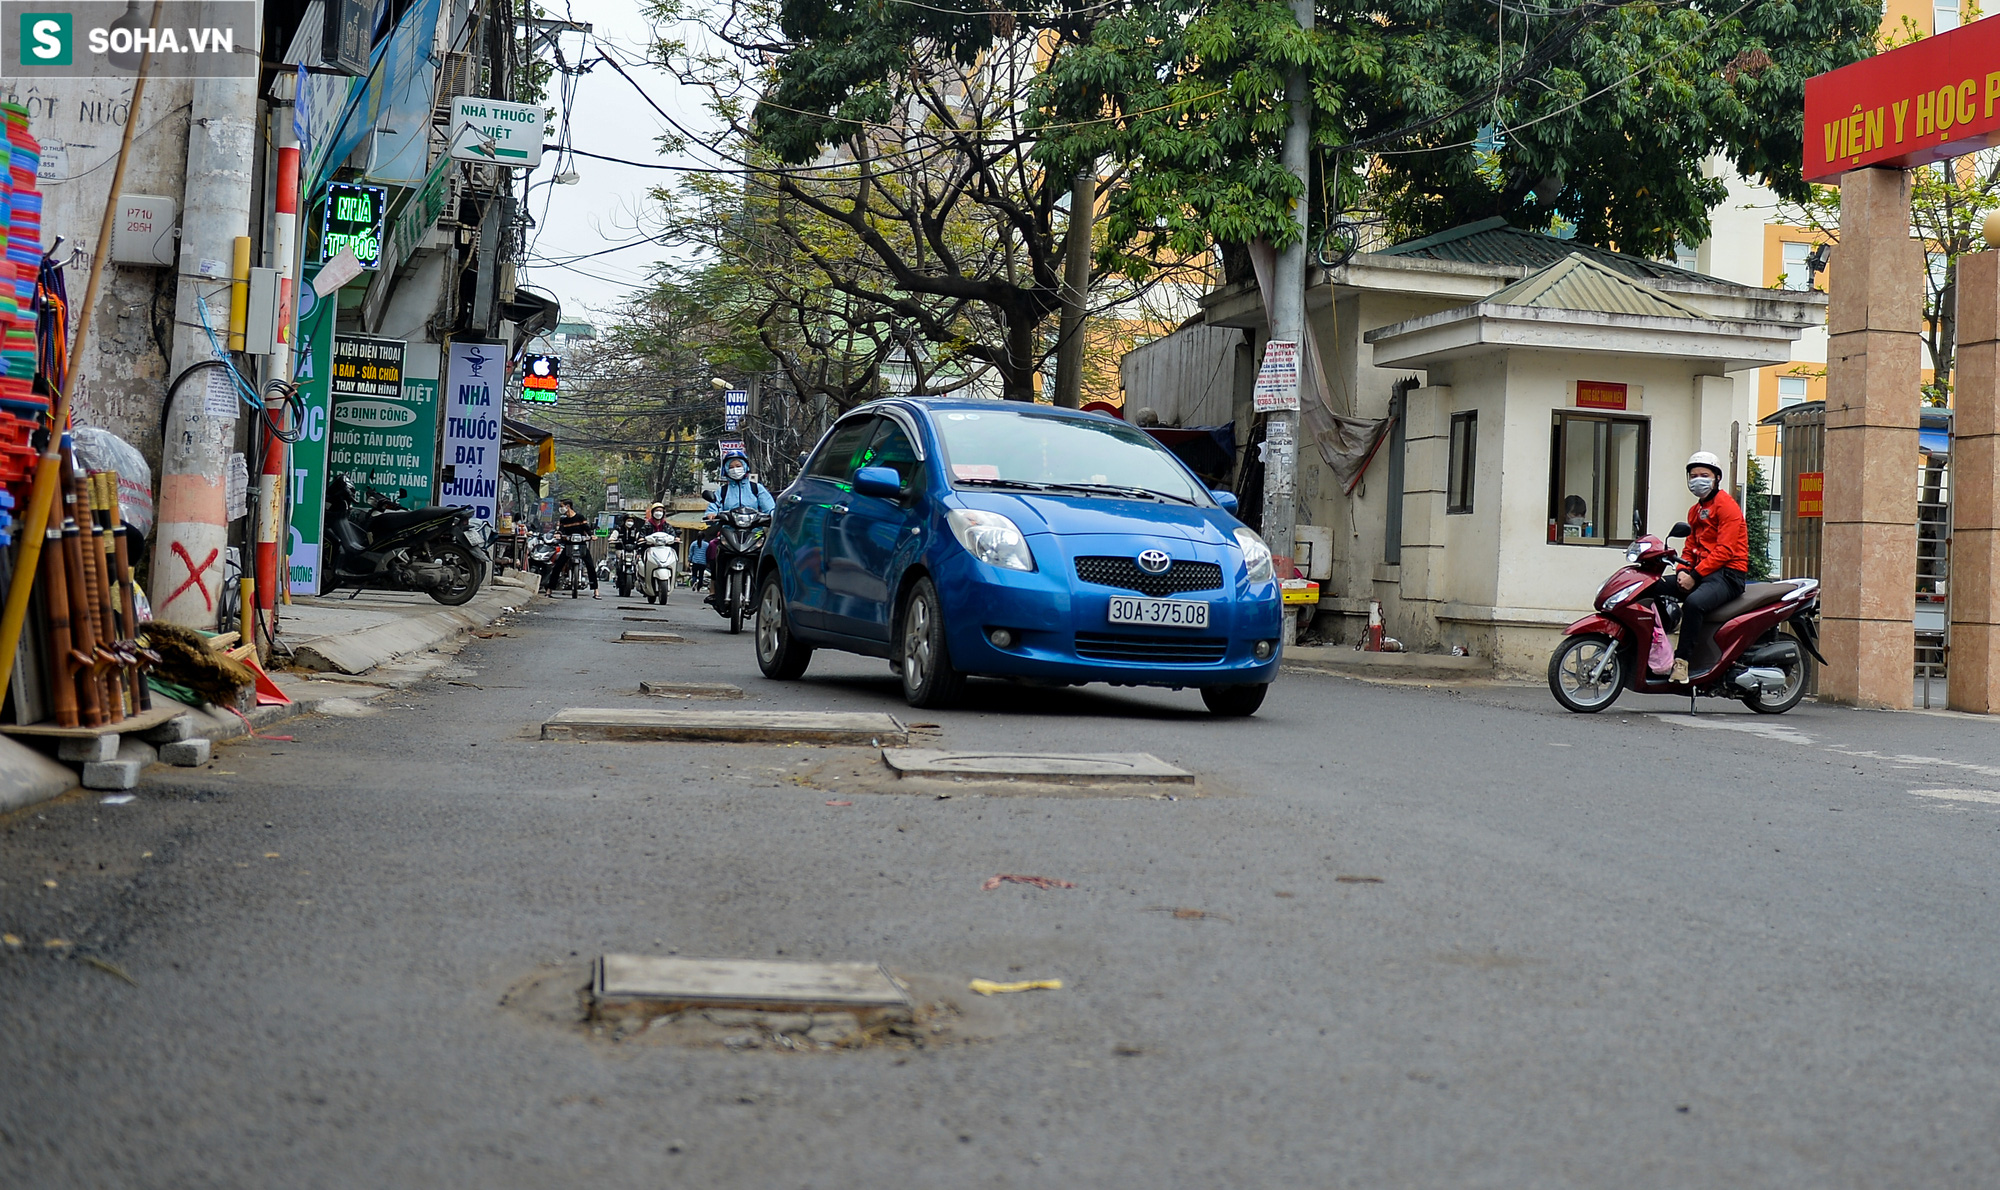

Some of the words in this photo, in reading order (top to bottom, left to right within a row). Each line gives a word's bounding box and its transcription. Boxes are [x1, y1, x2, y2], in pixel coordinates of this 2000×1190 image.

[461, 104, 487, 118] NHÀ
[492, 108, 535, 124] THUỐC
[1824, 104, 1884, 165] VIỆN
[1892, 99, 1909, 143] Y
[1916, 79, 1976, 140] HỌC
[483, 125, 512, 140] VIỆT
[127, 208, 153, 220] P710
[337, 194, 372, 223] NHÀ
[327, 228, 377, 260] THUỐC
[340, 340, 359, 360] KIỆN
[360, 342, 378, 361] ĐIỆN
[379, 345, 401, 364] THOẠI
[339, 362, 356, 378] BÁN
[362, 362, 377, 380] SỬA
[379, 366, 399, 382] CHỮA
[336, 380, 356, 392] THAY
[357, 381, 376, 394] MÀN
[378, 382, 398, 395] HÌNH
[403, 384, 433, 405] VIỆT
[459, 382, 490, 406] NHÀ
[351, 407, 376, 422] ĐỊNH
[380, 405, 408, 422] CÔNG
[449, 412, 497, 440] THUỐC
[333, 428, 361, 445] HUỐC
[363, 431, 383, 446] TÂN
[386, 434, 413, 450] DƯỢC
[331, 447, 351, 464] UỐC
[354, 451, 394, 466] CHUYÊN
[396, 453, 419, 470] VIỆN
[455, 445, 485, 468] ĐẠT
[399, 473, 428, 487] NĂNG
[442, 469, 496, 498] CHUẨN
[1112, 600, 1206, 625] 30A-375.08
